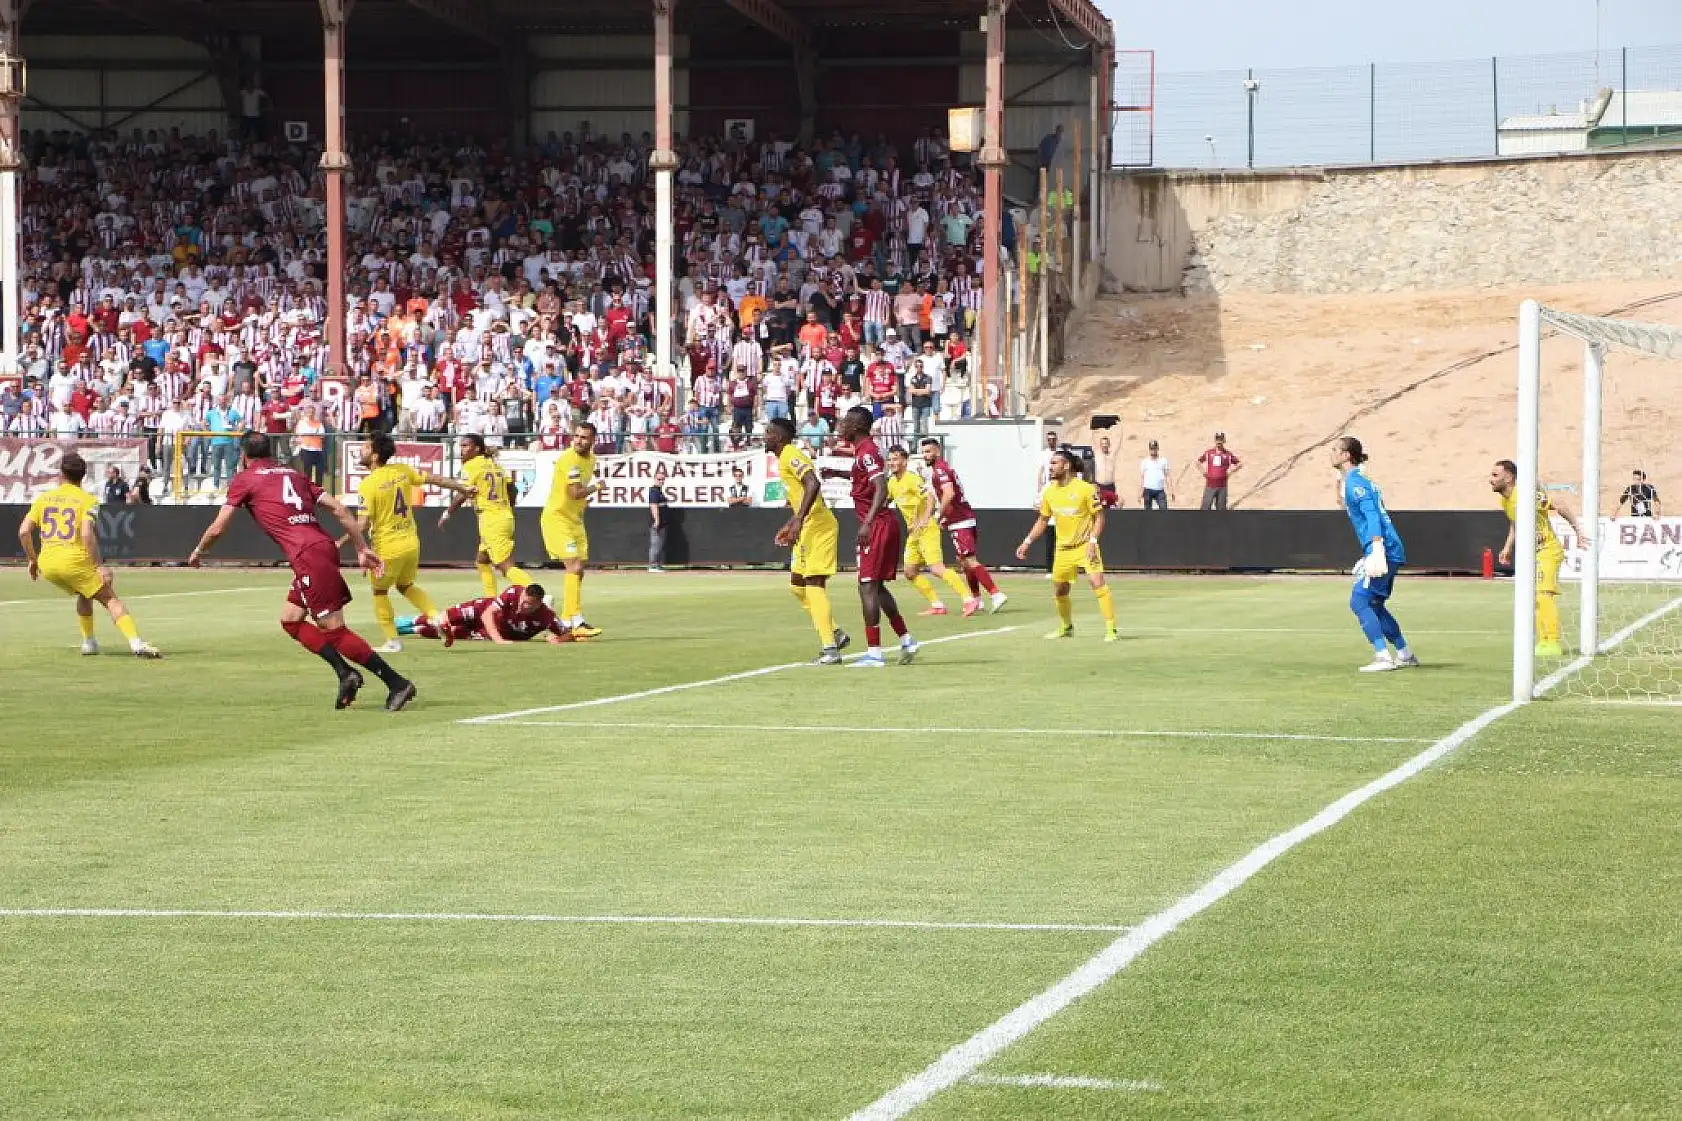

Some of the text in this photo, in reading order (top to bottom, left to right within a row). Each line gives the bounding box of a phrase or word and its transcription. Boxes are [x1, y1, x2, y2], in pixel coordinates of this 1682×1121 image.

[289, 124, 305, 140] D
[282, 475, 304, 511] 4
[393, 487, 408, 519] 4
[589, 486, 726, 504] ERKSLER
[41, 505, 76, 540] 53
[1620, 524, 1682, 546] BAN
